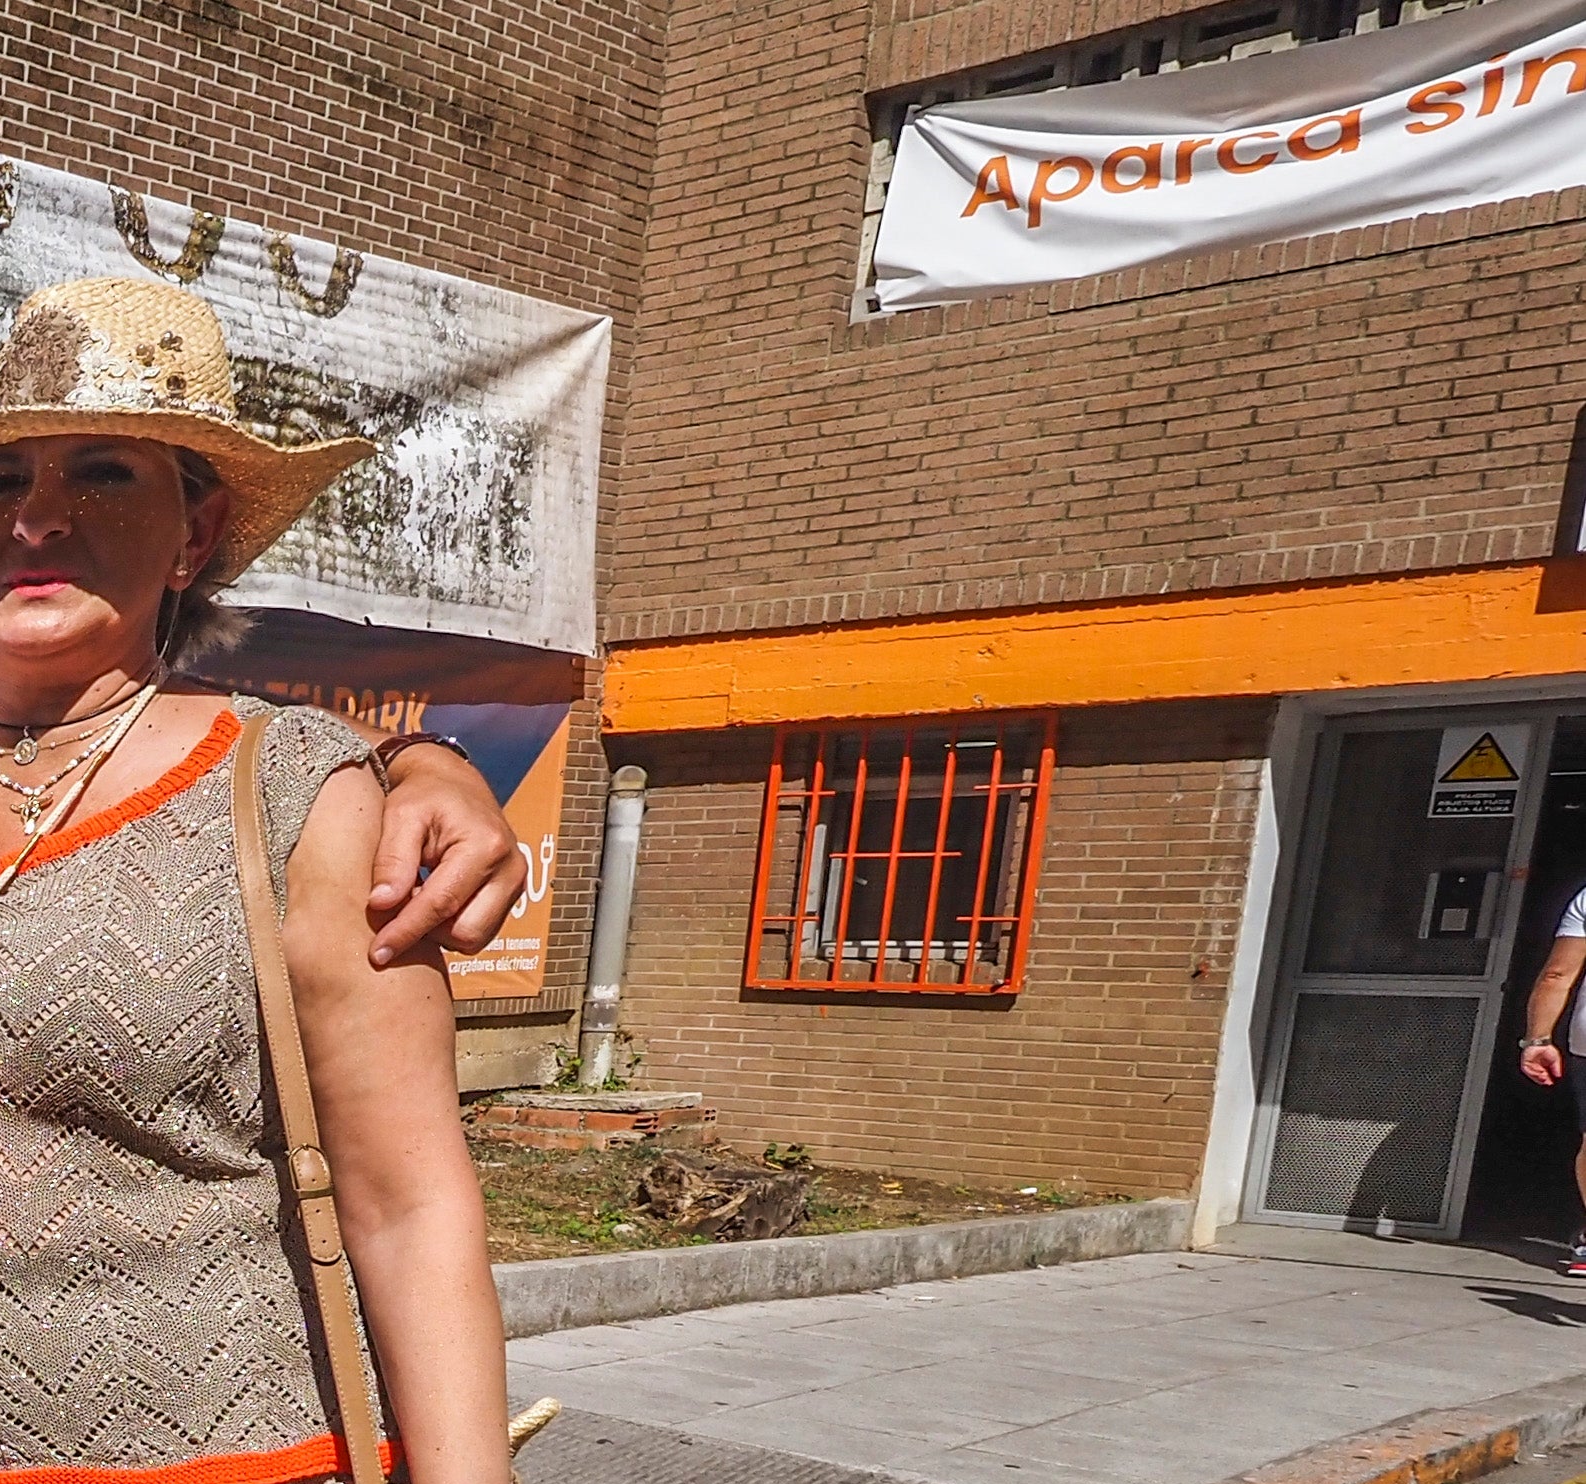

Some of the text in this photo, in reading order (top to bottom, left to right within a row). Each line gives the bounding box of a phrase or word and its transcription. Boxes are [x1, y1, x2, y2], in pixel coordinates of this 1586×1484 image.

[960, 46, 1586, 229] Aparca sin
[505, 938, 541, 951] tenemos
[448, 957, 495, 977] cargadores
